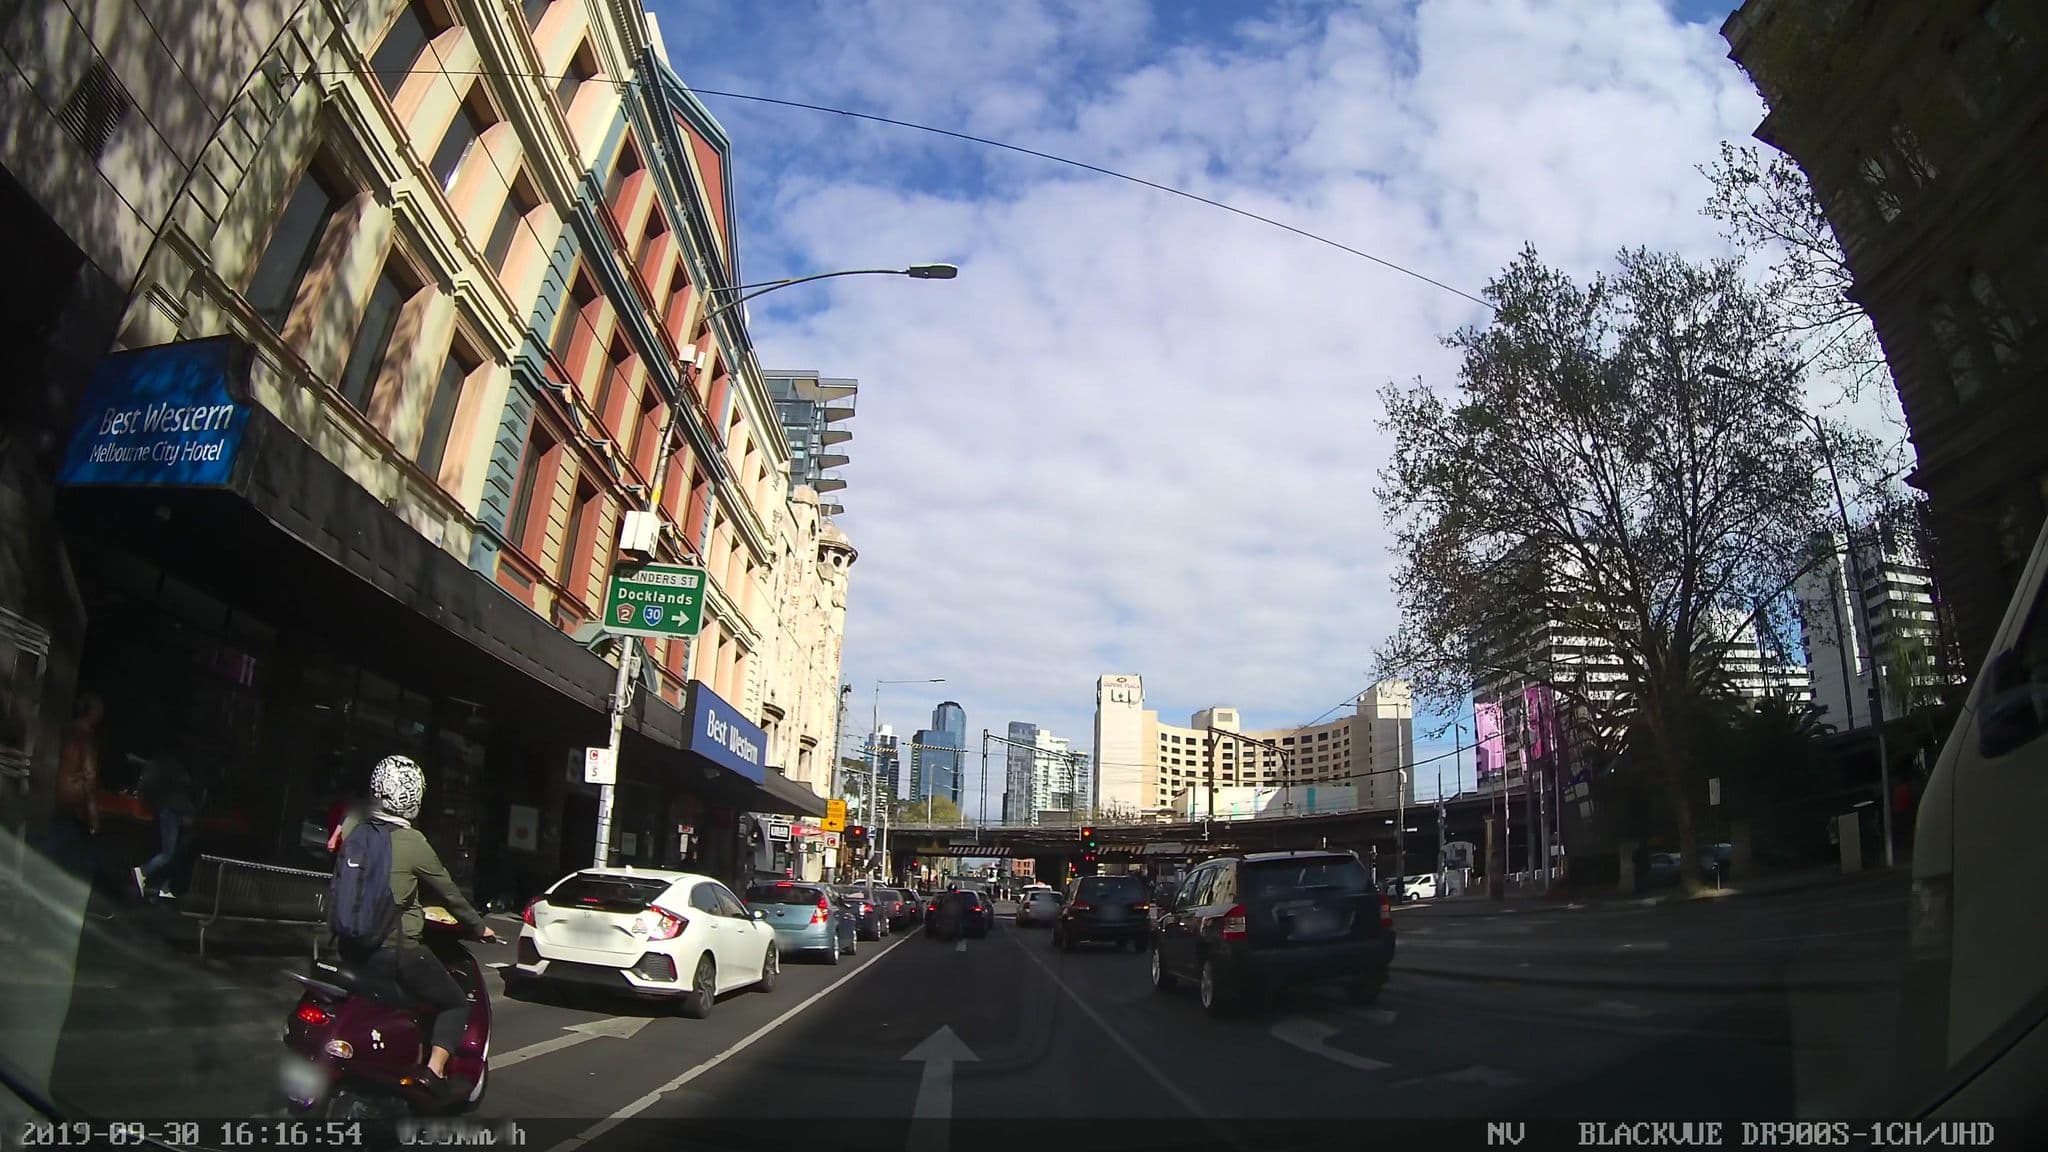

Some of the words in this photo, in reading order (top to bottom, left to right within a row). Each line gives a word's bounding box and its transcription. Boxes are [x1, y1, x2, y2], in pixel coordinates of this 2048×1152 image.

[99, 407, 141, 435] Best
[143, 402, 233, 433] Western
[89, 441, 150, 463] Melbourne
[152, 440, 180, 466] City
[181, 439, 224, 461] Hotel
[628, 572, 677, 585] INDERS
[680, 576, 695, 587] ST
[618, 587, 693, 605] Docklands
[620, 609, 630, 621] 2
[646, 608, 661, 621] 30
[707, 709, 728, 746] Best
[729, 724, 758, 765] Western
